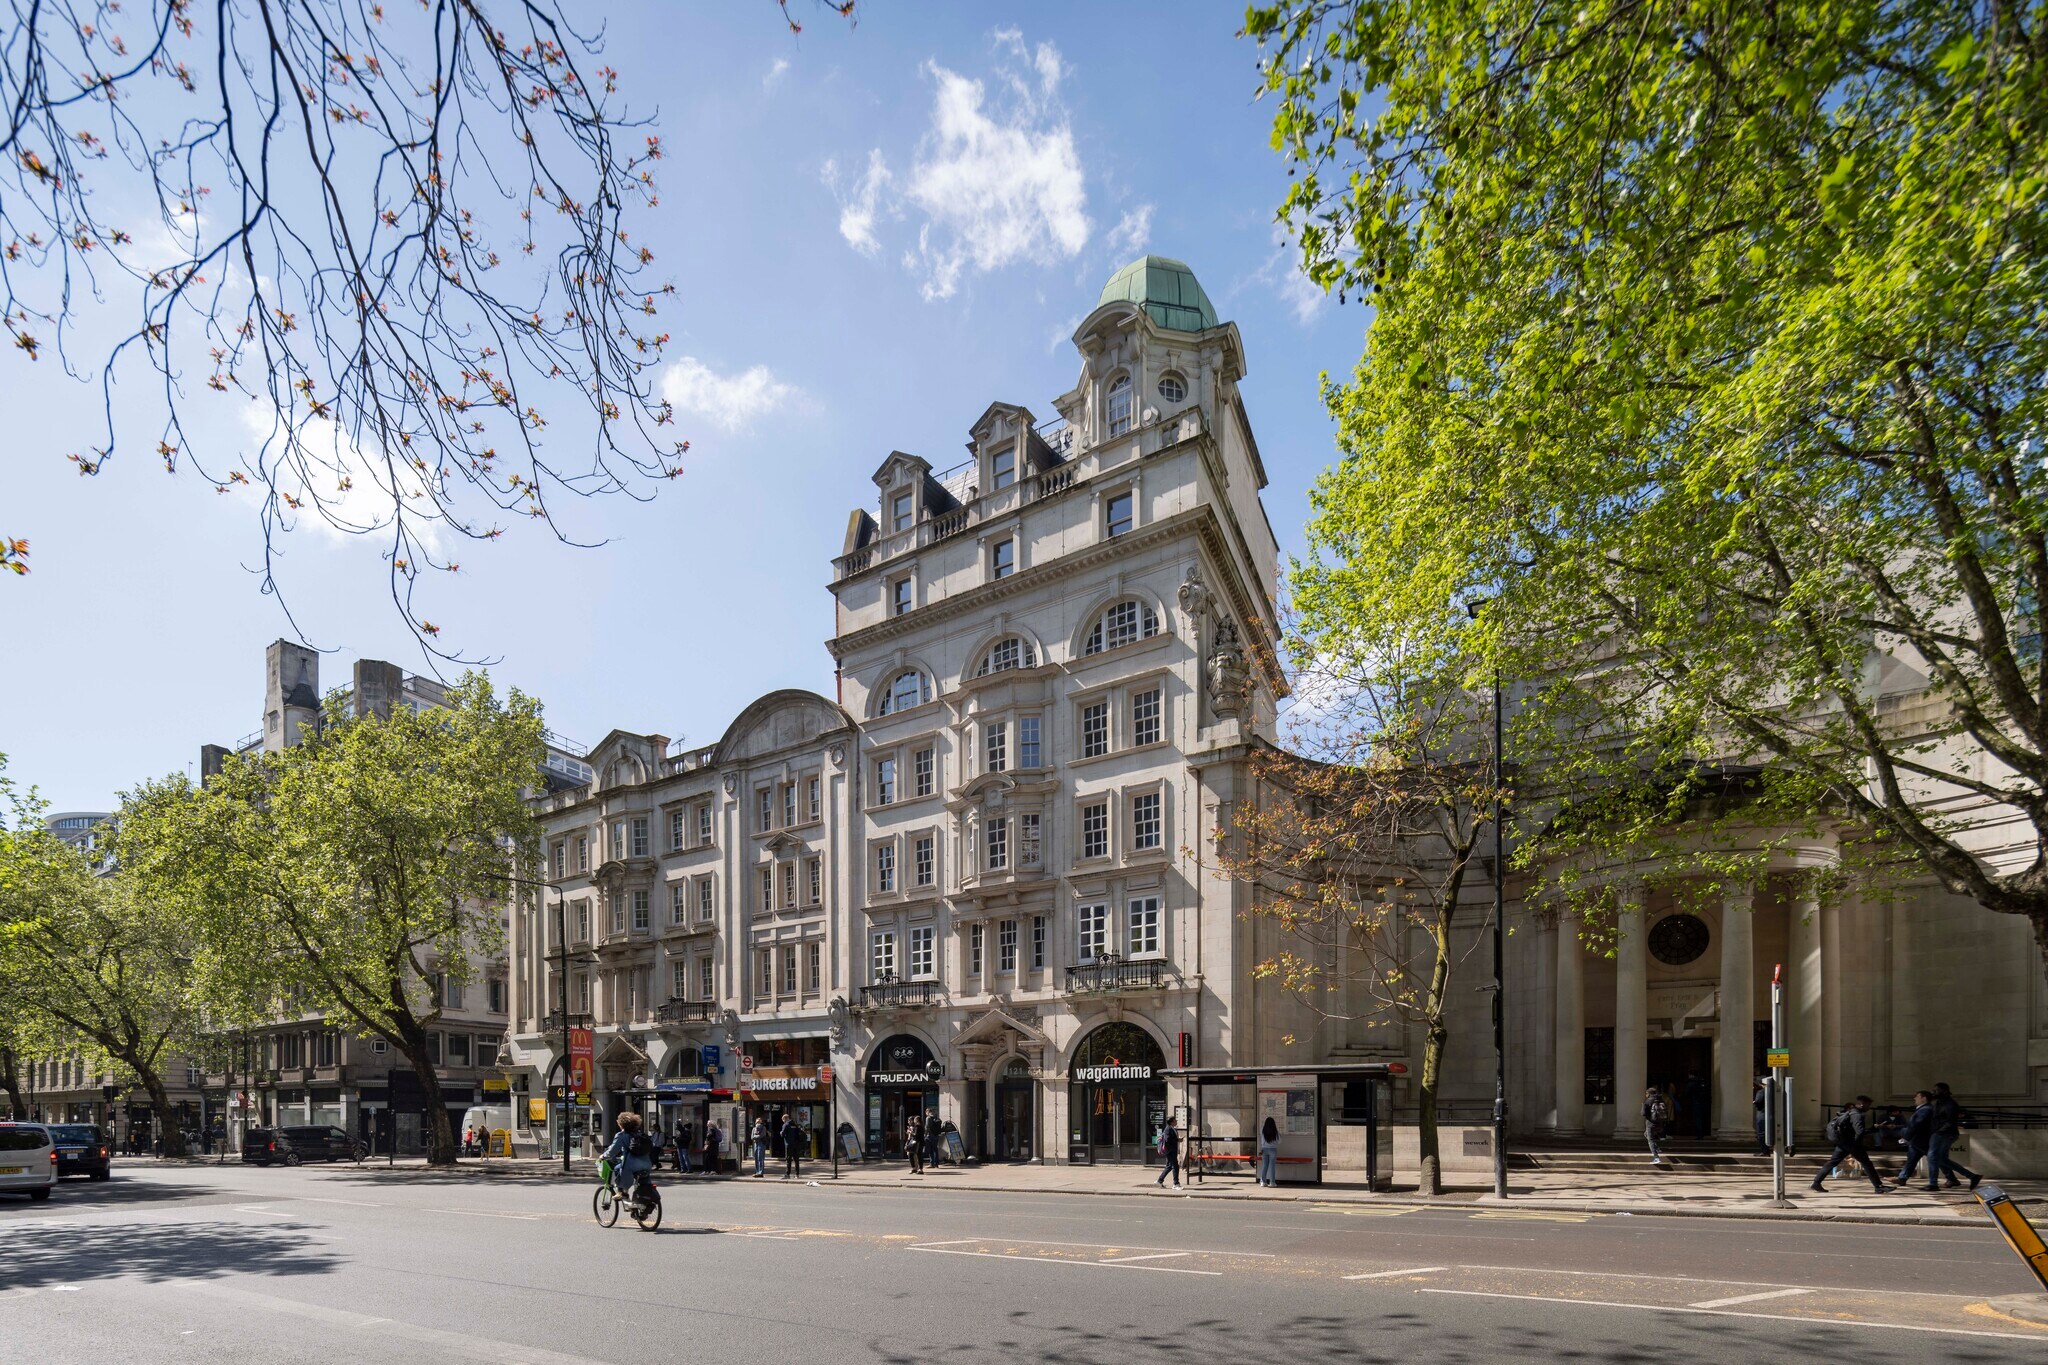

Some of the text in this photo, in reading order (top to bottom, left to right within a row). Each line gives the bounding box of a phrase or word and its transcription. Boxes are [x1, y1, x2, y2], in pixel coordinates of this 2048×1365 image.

[1009, 1067, 1023, 1075] 121
[1076, 1066, 1151, 1082] wagamama
[752, 1078, 788, 1091] BURGER
[790, 1077, 816, 1090] KING
[871, 1073, 929, 1083] TRUEDAN
